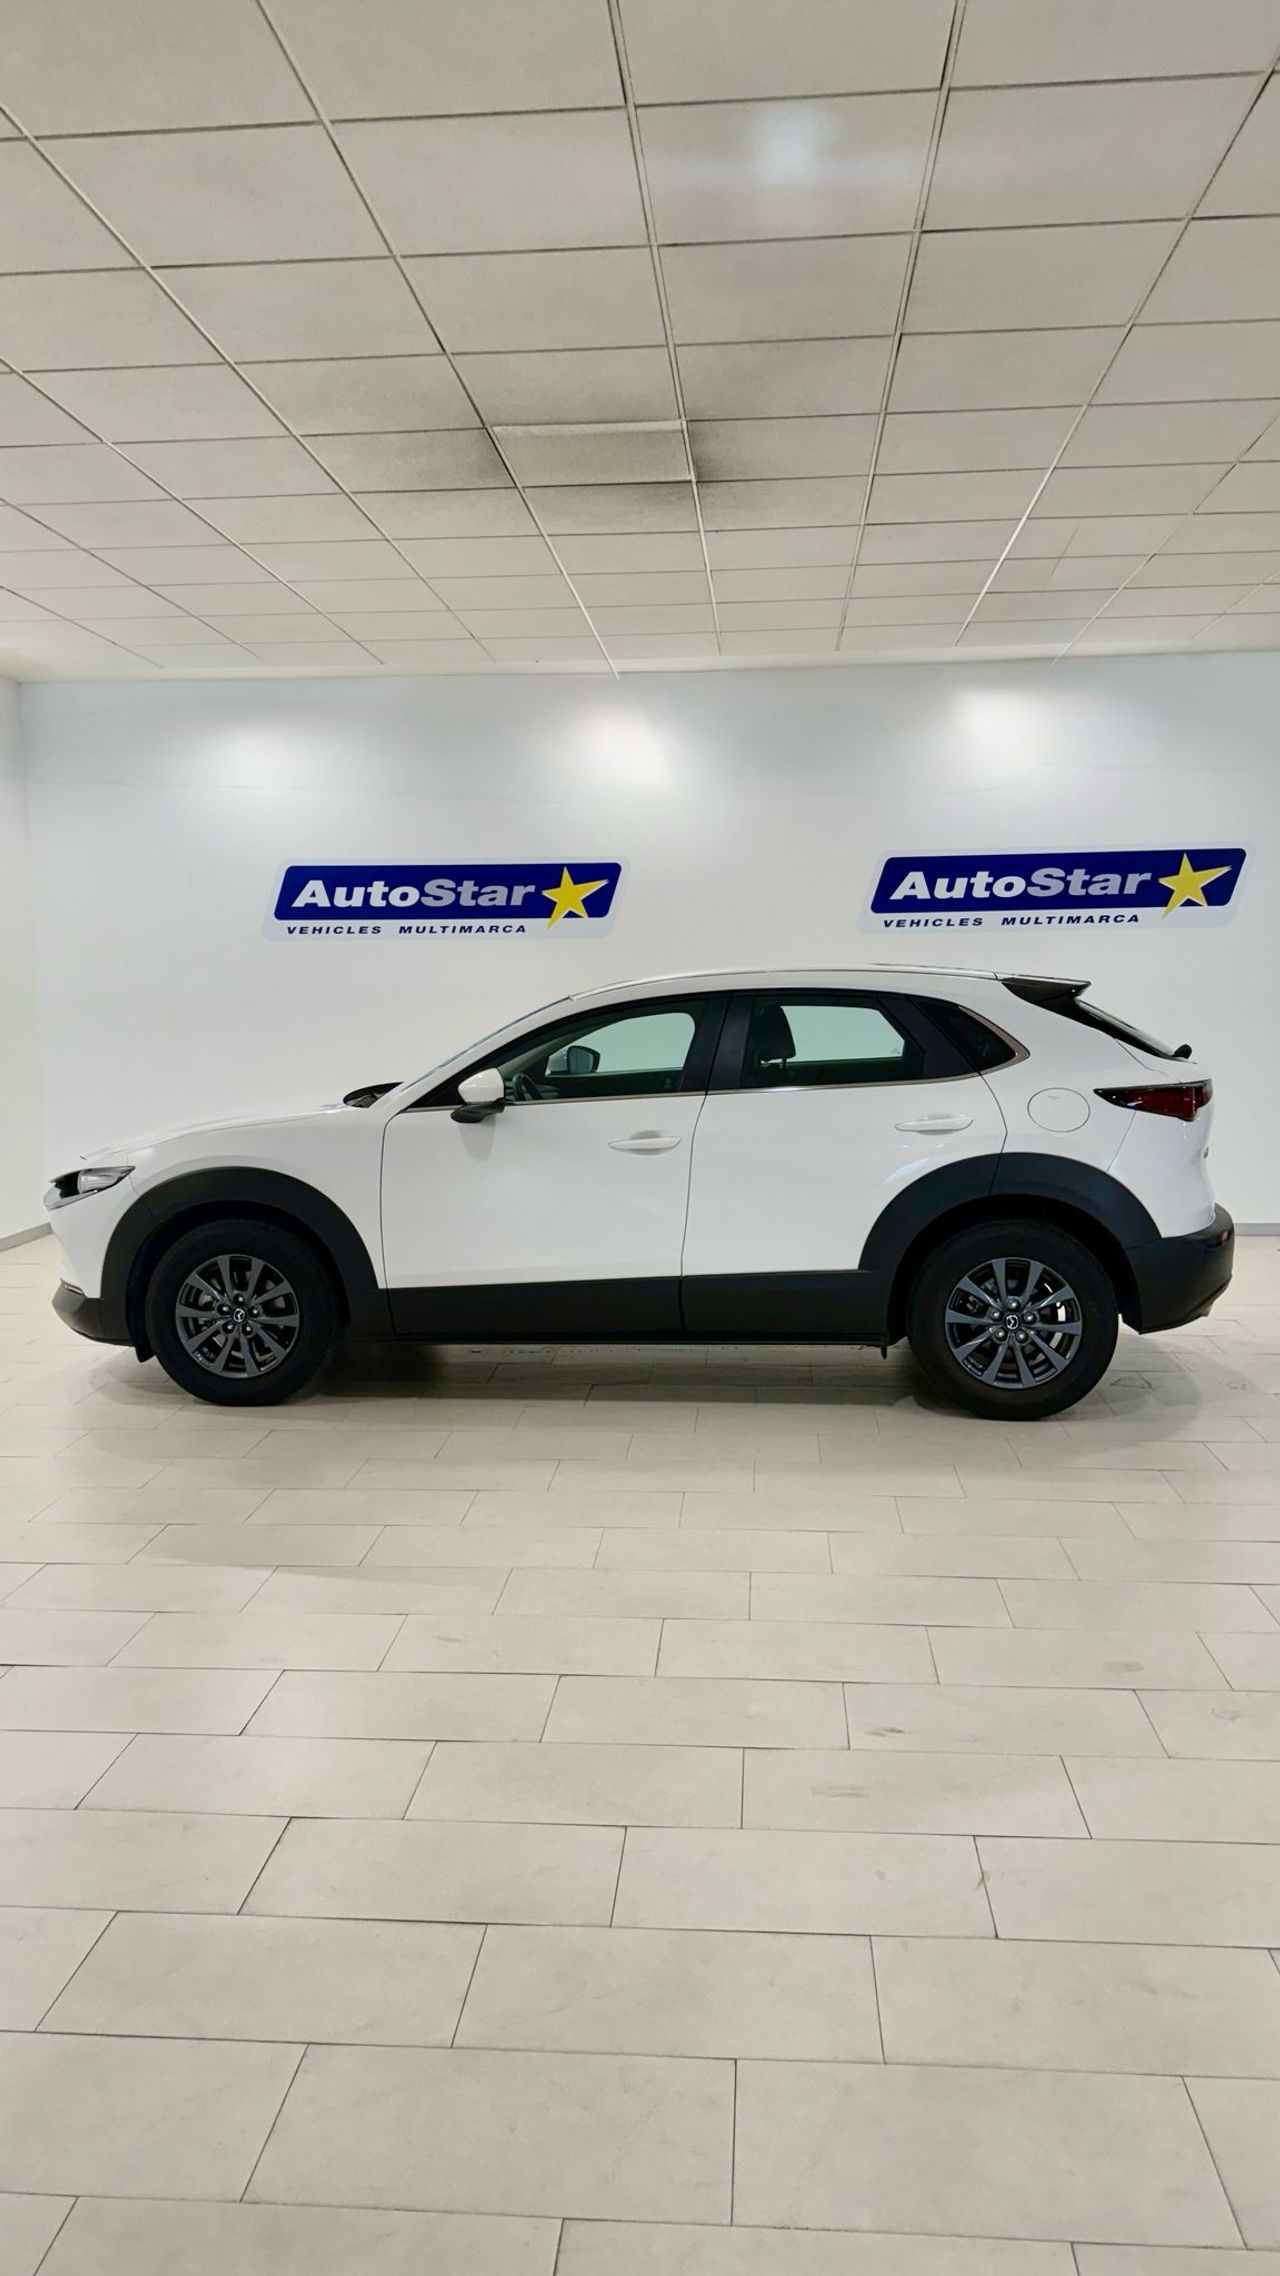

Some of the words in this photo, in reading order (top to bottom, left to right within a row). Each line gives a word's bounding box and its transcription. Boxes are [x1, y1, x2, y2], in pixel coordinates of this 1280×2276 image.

[291, 878, 535, 908] AutoStar
[889, 867, 1152, 900] AutoStar
[286, 925, 382, 935] VEHICLES
[399, 924, 527, 934] MULTIMARCA
[883, 917, 983, 928] VEHICLES
[1001, 913, 1139, 926] MULTIMARCA
